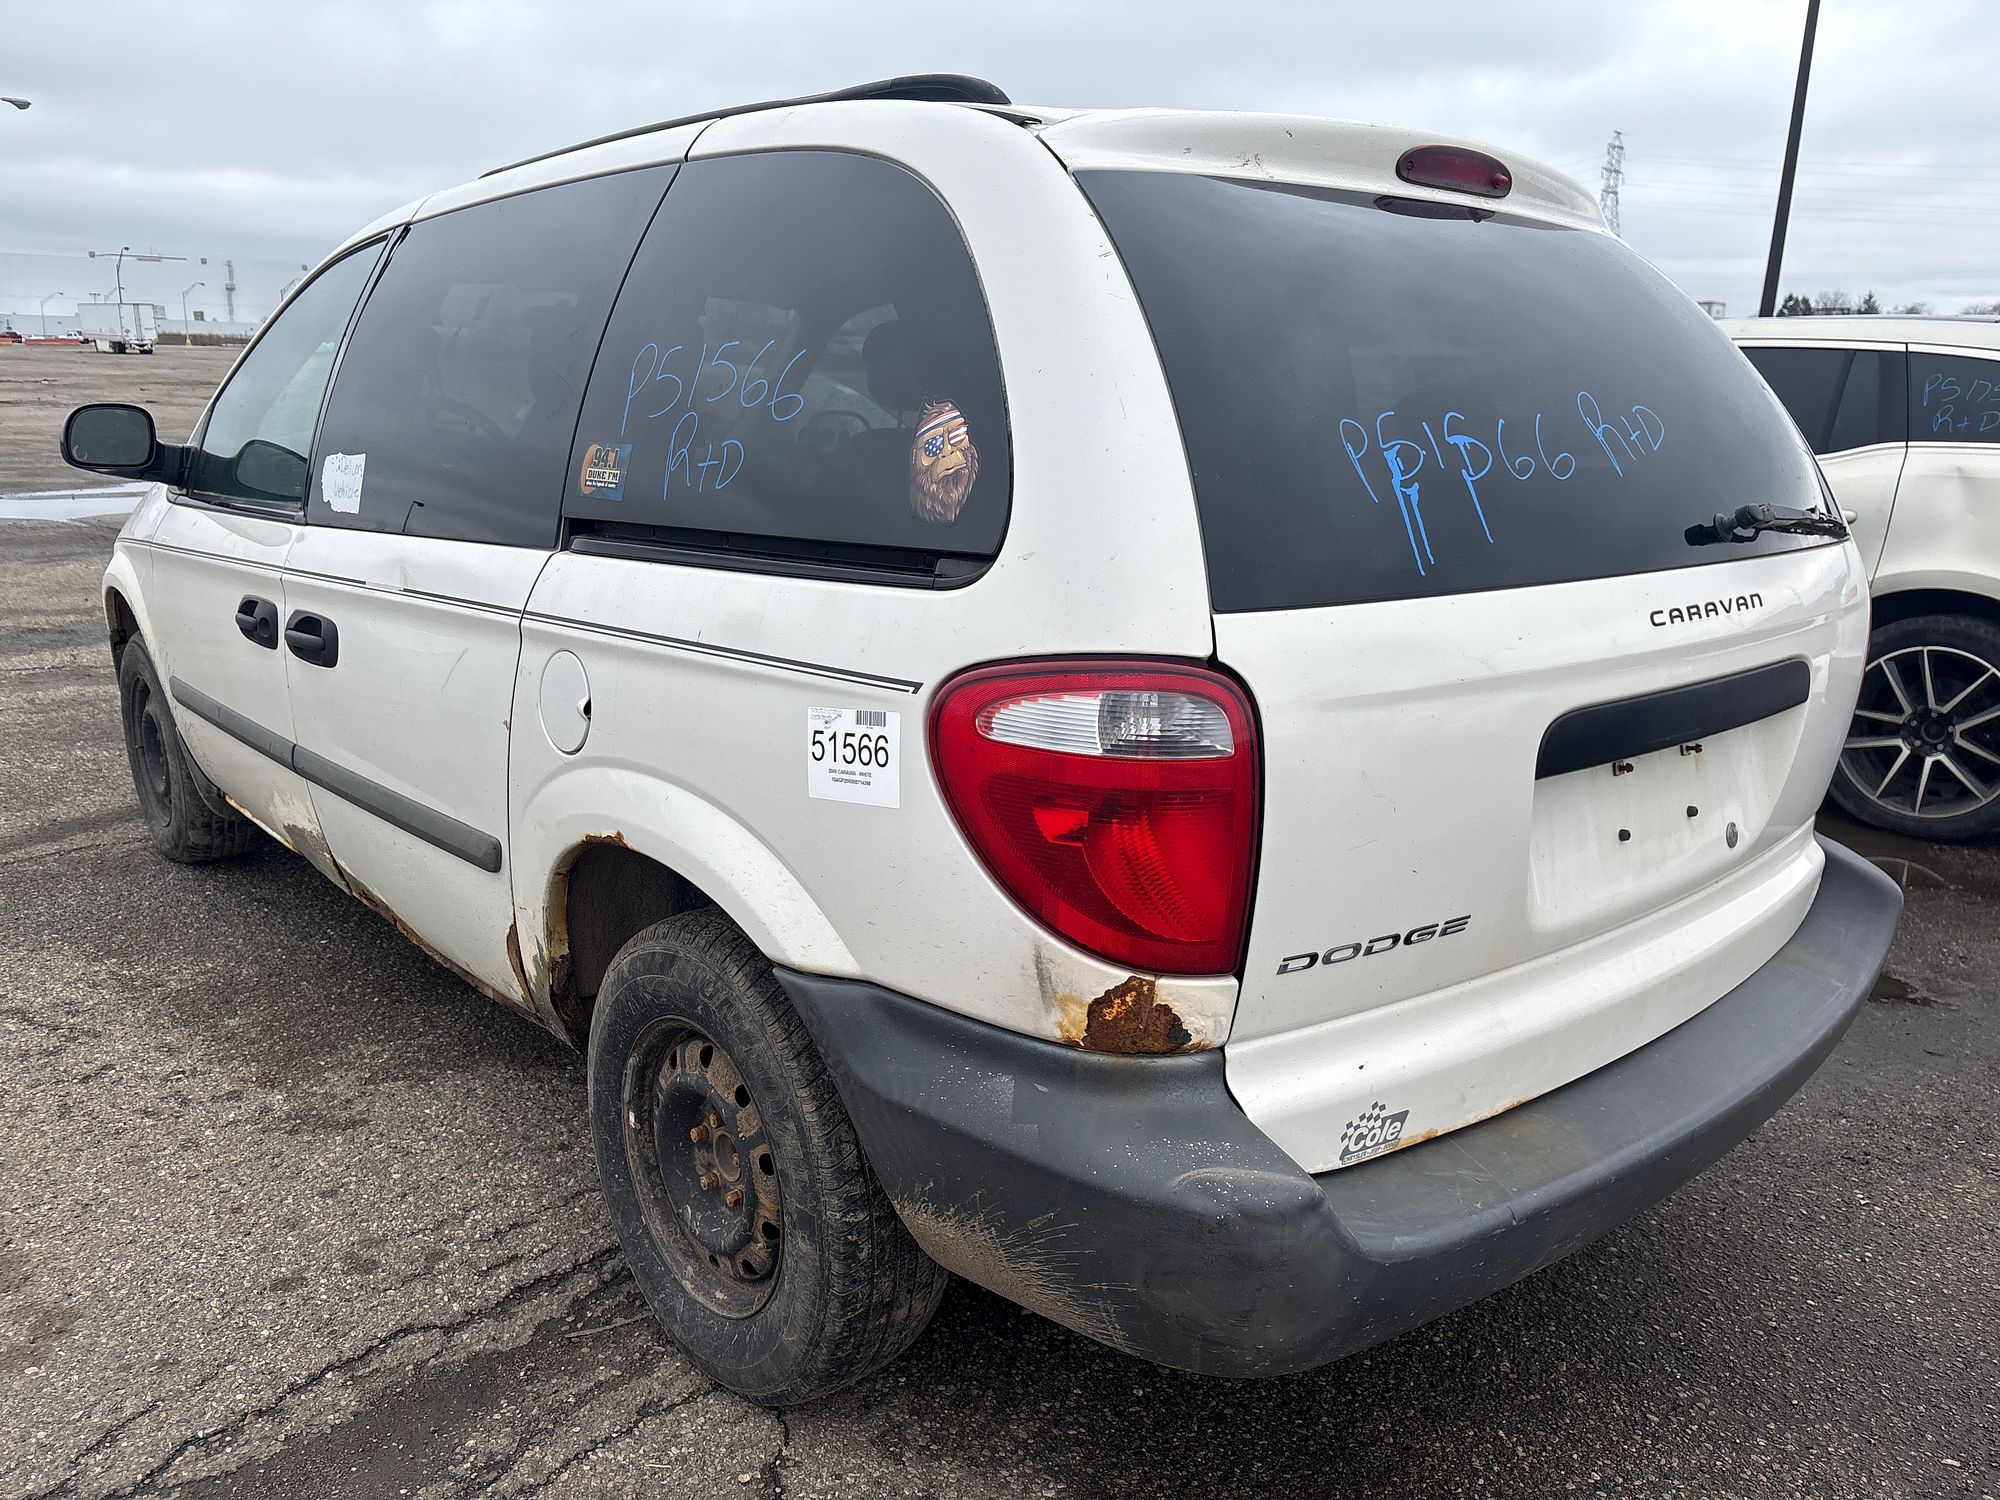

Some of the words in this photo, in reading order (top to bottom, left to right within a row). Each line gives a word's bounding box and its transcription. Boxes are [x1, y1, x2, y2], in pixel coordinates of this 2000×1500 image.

[620, 339, 807, 437] P51566
[588, 470, 606, 480] DUKE
[607, 472, 619, 481] FM
[593, 447, 620, 469] 94.1
[1649, 592, 1764, 628] CARAVAN
[811, 729, 890, 768] 51566
[1275, 914, 1472, 976] DODGE
[1348, 1118, 1402, 1153] Cole
